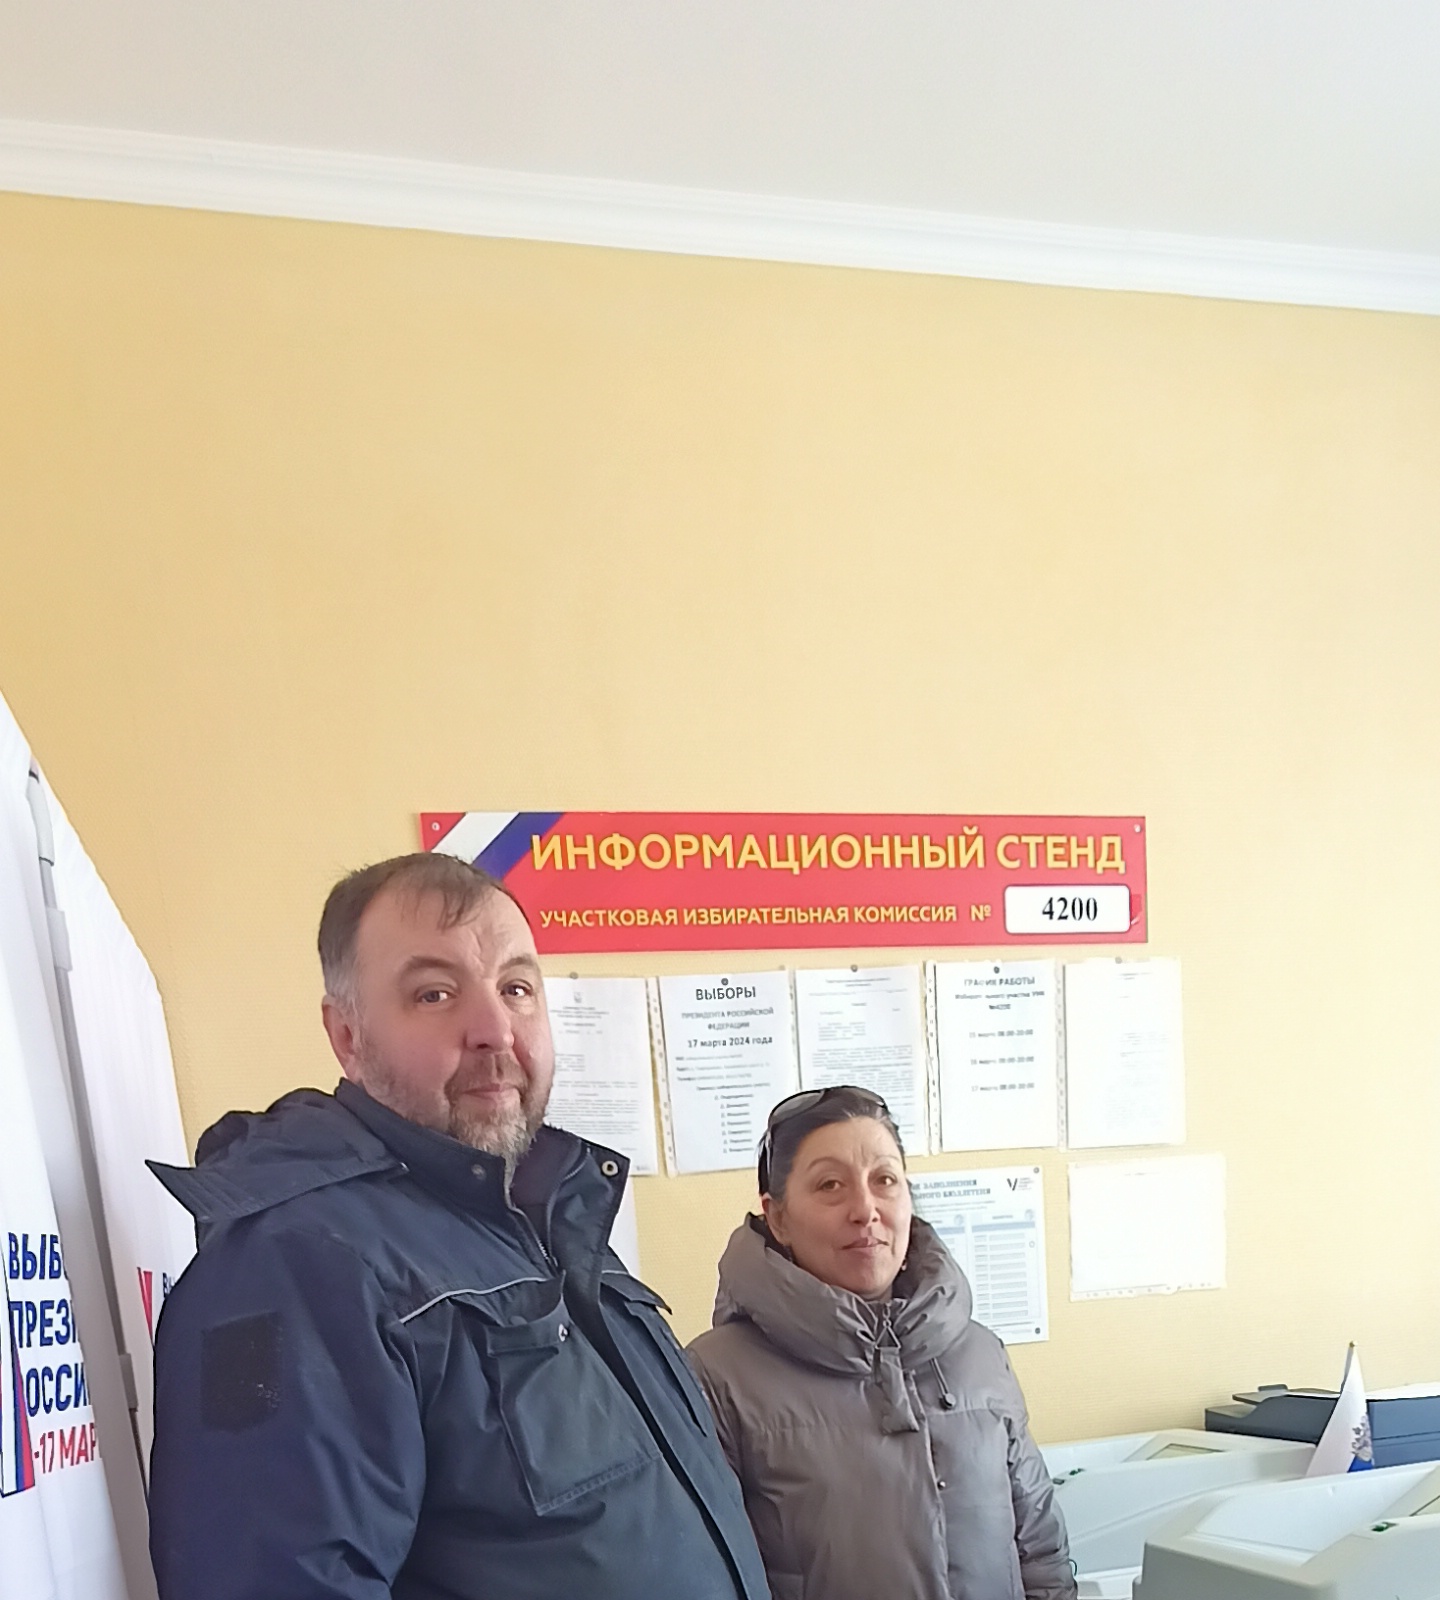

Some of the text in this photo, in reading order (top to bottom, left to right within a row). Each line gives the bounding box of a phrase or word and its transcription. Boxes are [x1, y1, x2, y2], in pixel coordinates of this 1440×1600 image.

[531, 825, 1126, 875] ИНФОРМАЦИОННЫЙ СТЕНД
[540, 896, 1098, 928] УЧАСТКОВАЯ ИЗБИРАТЕЛЬНАЯ КОМИССИЯ № 4200
[695, 986, 756, 1001] ВЫБОРЫ
[999, 976, 1036, 986] РАБОТЫ
[687, 1036, 773, 1049] 17 марта 2024 года
[8, 1231, 68, 1281] ВЫБ
[25, 1362, 91, 1417] ОССИ
[34, 1421, 98, 1474] -17 МАР
